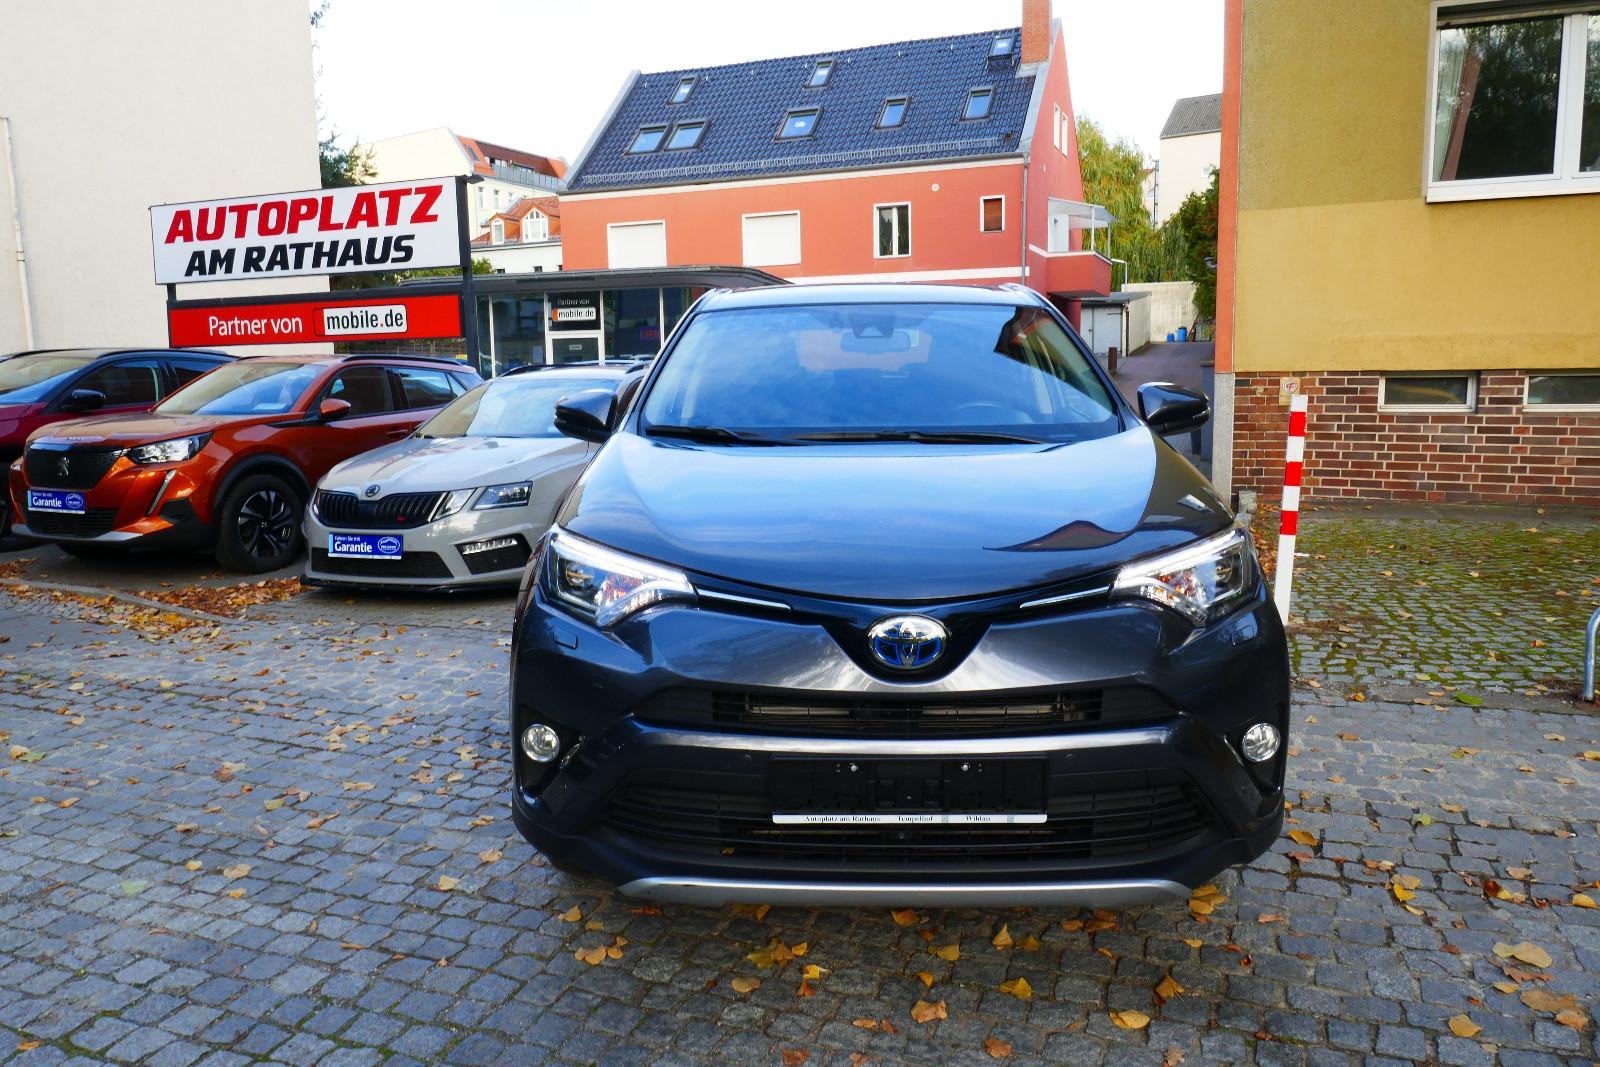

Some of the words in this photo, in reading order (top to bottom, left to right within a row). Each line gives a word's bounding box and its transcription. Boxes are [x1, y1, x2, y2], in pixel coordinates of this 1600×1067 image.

[164, 185, 444, 245] AUTOPLATZ
[184, 247, 236, 277] AM
[242, 234, 416, 273] RATHAUS
[558, 309, 595, 318] mobile.de
[208, 315, 269, 337] Partner
[271, 316, 303, 335] von
[326, 309, 404, 331] mobile.de
[32, 496, 62, 508] Garantie
[334, 541, 373, 553] Garantie
[805, 815, 838, 823] Autoplatz
[897, 815, 933, 823] Tempelhof
